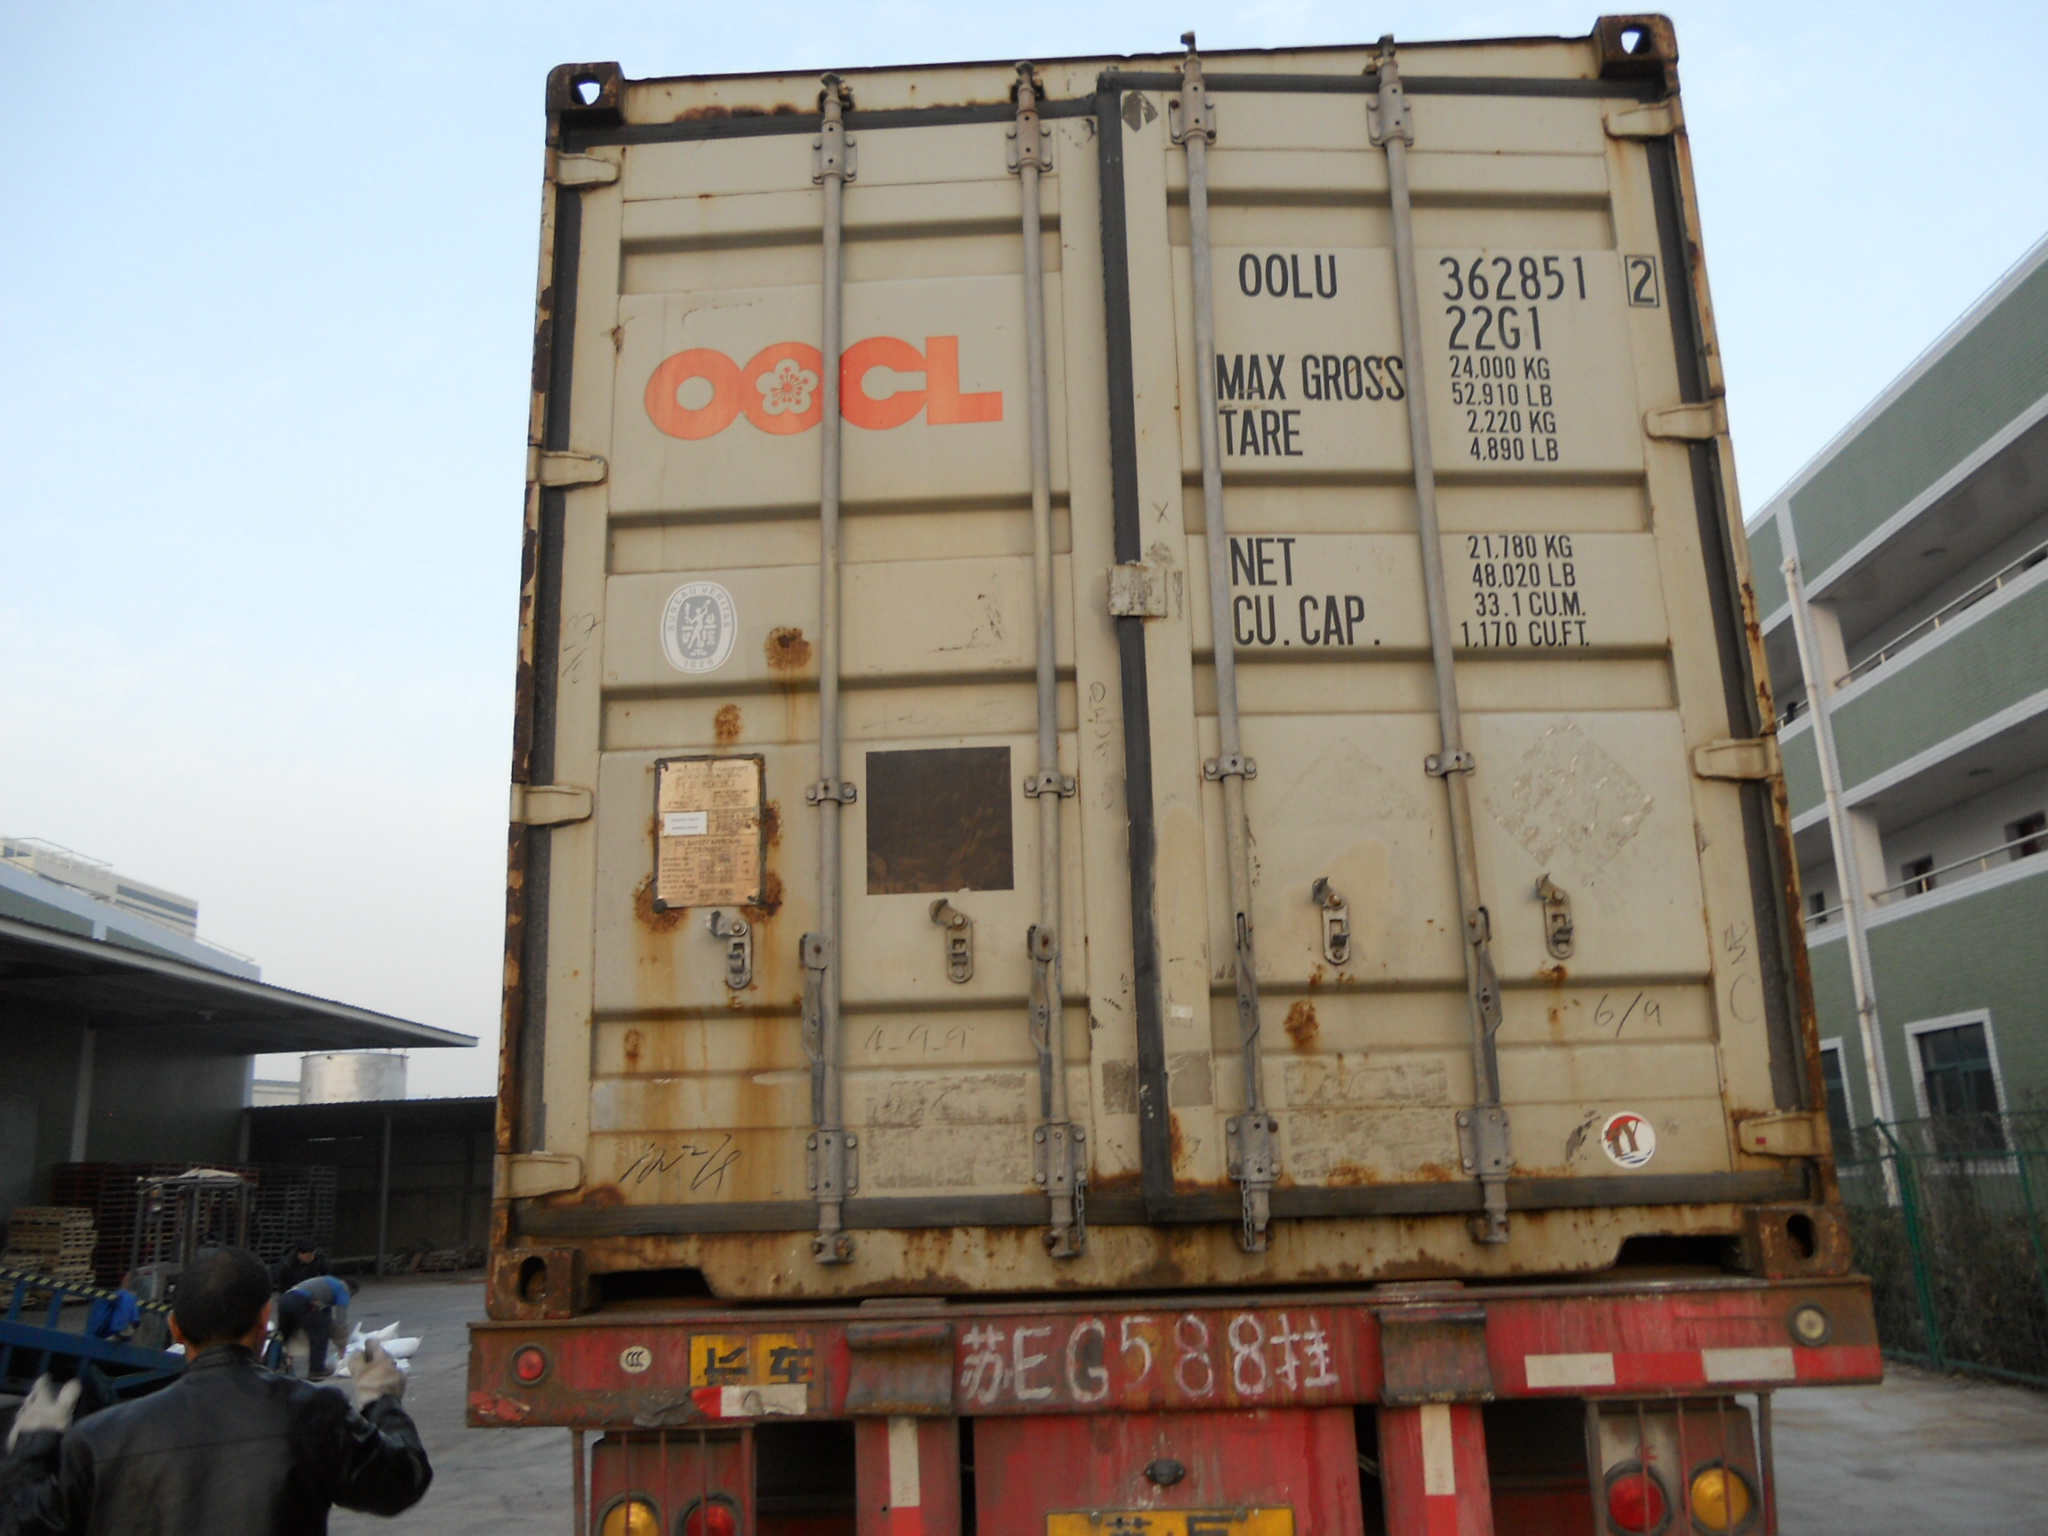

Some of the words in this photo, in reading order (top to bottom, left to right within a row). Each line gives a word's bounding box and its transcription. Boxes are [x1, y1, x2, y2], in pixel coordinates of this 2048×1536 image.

[1238, 253, 1338, 299] OOLU
[1438, 255, 1587, 300] 362851
[1629, 259, 1656, 303] 2
[1444, 305, 1542, 351] 22G1
[644, 335, 1004, 441] OOCL
[1215, 354, 1287, 401] MAX
[1301, 354, 1406, 401] GROSS
[1449, 355, 1517, 380] 24,000
[1523, 356, 1551, 380] KG
[1525, 383, 1553, 407] LB
[1218, 408, 1304, 457] TARE
[1528, 410, 1557, 434] KG
[1531, 437, 1559, 461] LB
[1229, 537, 1297, 587] NET
[1544, 534, 1574, 559] KG
[1547, 563, 1576, 587] LB
[666, 588, 697, 632] BUREAU
[702, 586, 732, 629] VERITAS
